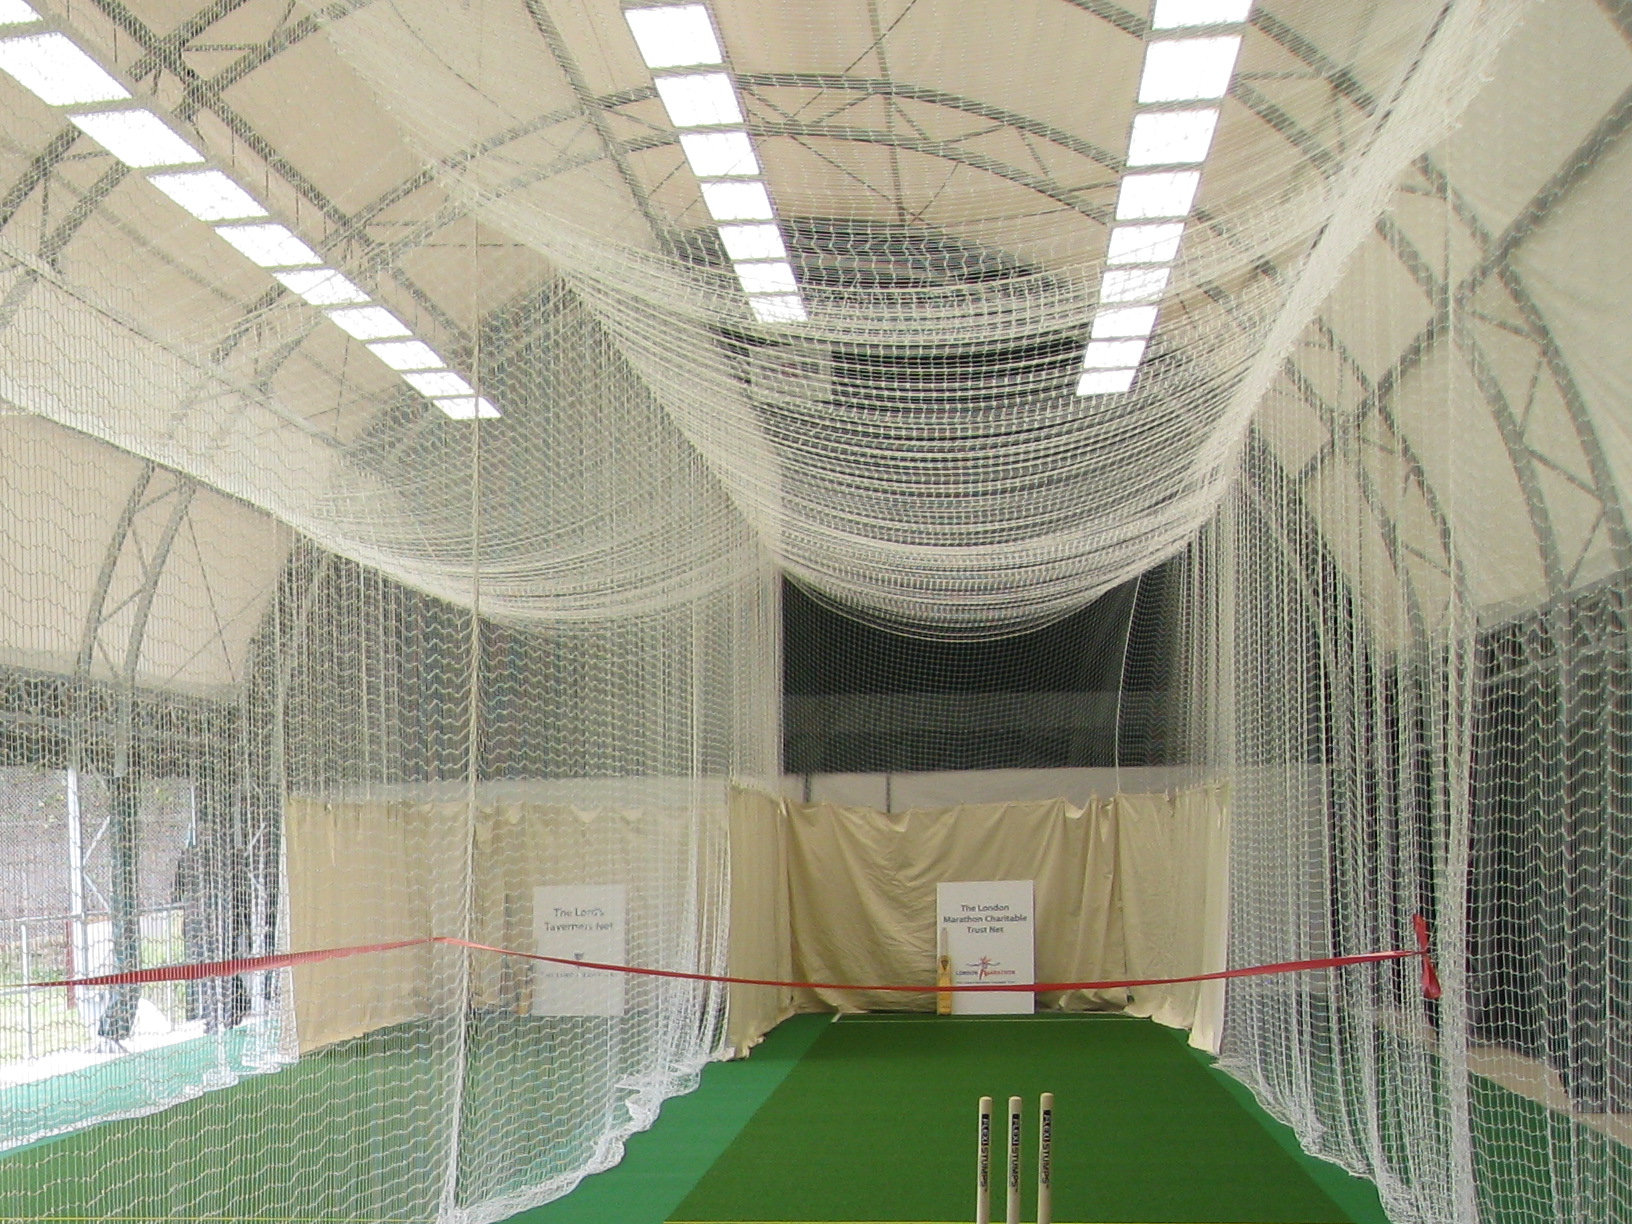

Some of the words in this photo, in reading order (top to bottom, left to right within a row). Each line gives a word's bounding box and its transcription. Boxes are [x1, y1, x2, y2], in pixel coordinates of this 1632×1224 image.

[554, 907, 572, 917] The
[961, 904, 976, 912] The
[978, 903, 1009, 912] London
[985, 914, 1027, 922] Charitable
